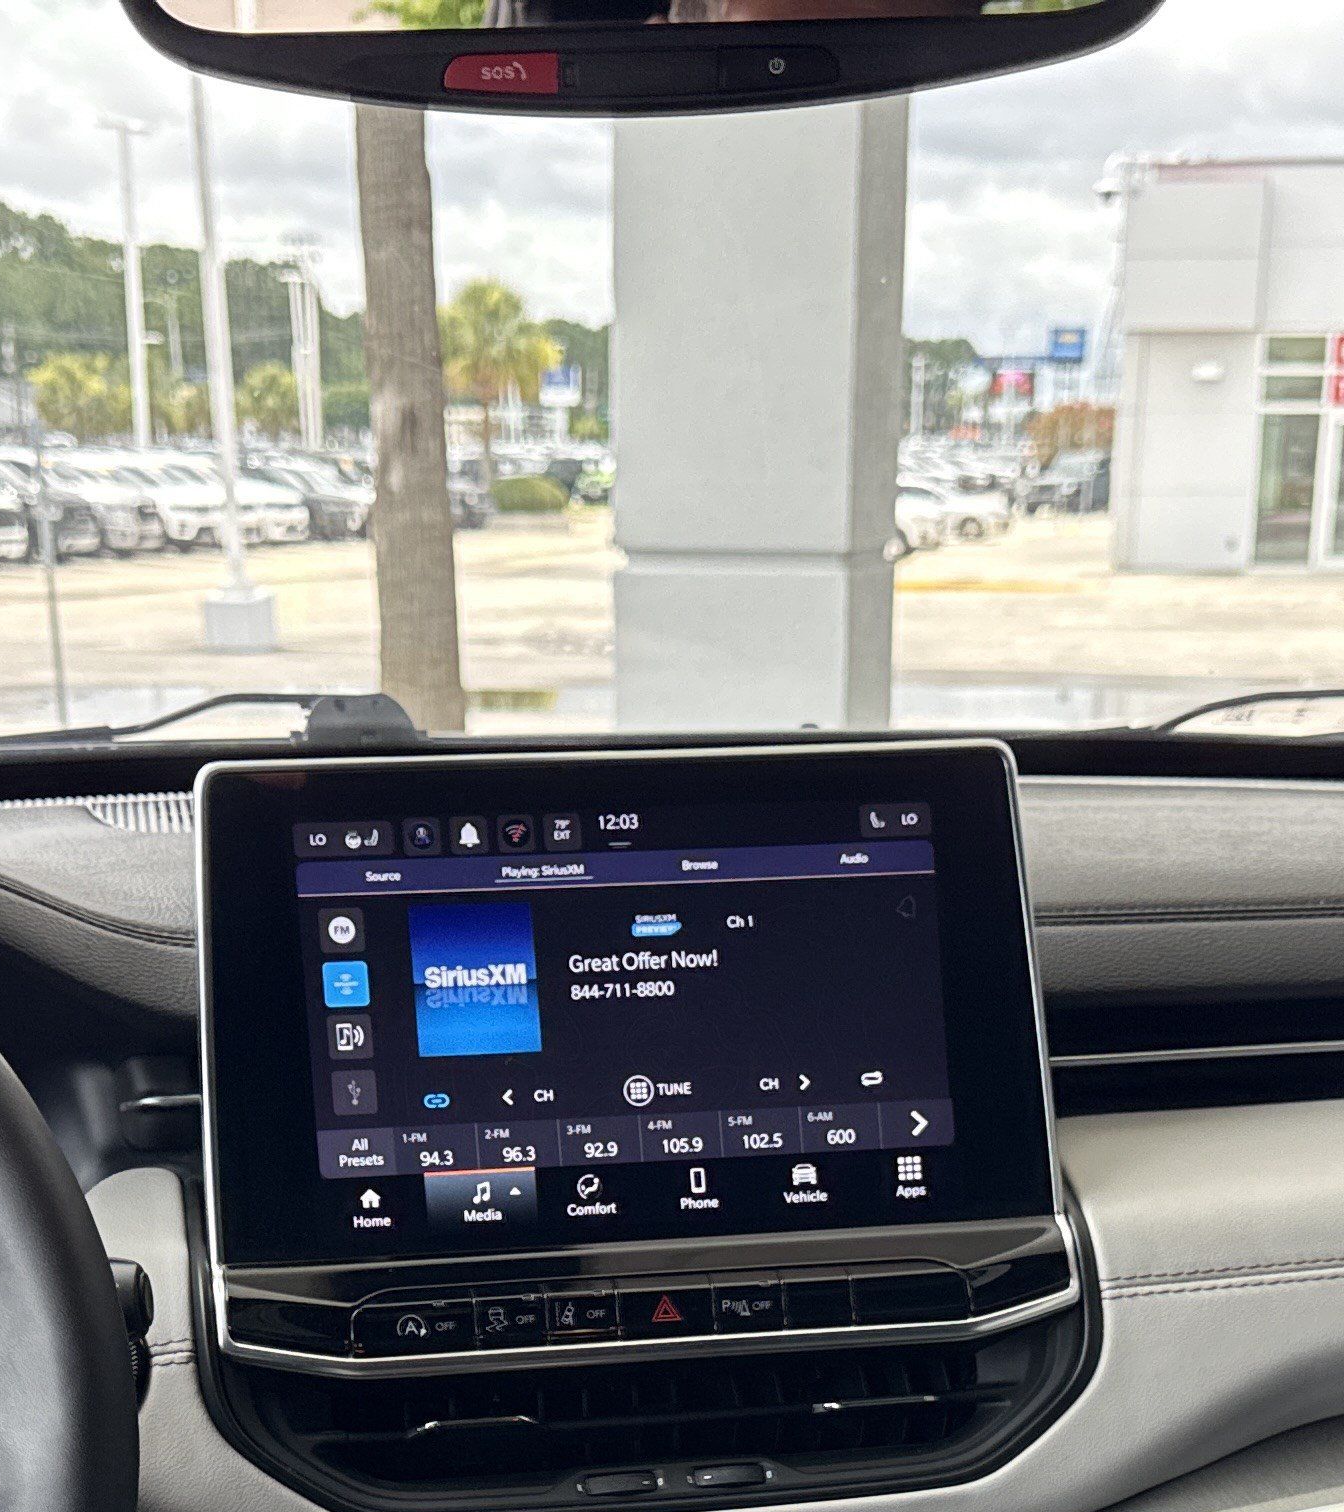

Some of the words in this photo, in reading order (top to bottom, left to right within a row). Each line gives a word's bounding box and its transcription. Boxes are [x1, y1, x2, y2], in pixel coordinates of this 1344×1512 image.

[481, 65, 515, 80] SOS
[598, 813, 639, 831] 12:03
[901, 812, 918, 825] LO
[309, 833, 327, 846] LO
[681, 859, 718, 872] Browse
[839, 852, 869, 865] Audio
[365, 870, 402, 883] Source
[541, 863, 585, 877] SiriusXM
[726, 915, 745, 929] Ch
[747, 915, 754, 928] 1
[333, 924, 351, 936] FM
[568, 953, 620, 973] Great
[622, 951, 669, 971] Offer
[671, 948, 719, 969] Now!
[424, 962, 527, 989] SiriusXM
[570, 980, 675, 1001] 844-711-8800
[656, 1082, 692, 1096] TUNE
[759, 1077, 780, 1091] CH
[534, 1089, 554, 1103] CH
[727, 1115, 753, 1127] 5-FM
[807, 1111, 834, 1123] 6-AM
[566, 1124, 592, 1136] 3-FM
[647, 1119, 673, 1131] 4-FM
[402, 1132, 427, 1144] 1-FM
[484, 1128, 510, 1140] 2-FM
[742, 1132, 783, 1150] 102.5
[826, 1128, 856, 1145] 600
[351, 1137, 369, 1151] All
[583, 1141, 618, 1159] 92.9
[662, 1136, 704, 1154] 105.9
[338, 1153, 384, 1167] Presets
[419, 1150, 454, 1167] 94.3
[502, 1146, 536, 1163] 96.3
[783, 1189, 828, 1204] Vehicle
[896, 1184, 927, 1198] Apps
[566, 1202, 617, 1217] Comfort
[680, 1196, 719, 1210] Phone
[353, 1215, 392, 1228] Home
[463, 1208, 503, 1222] Media
[751, 1300, 773, 1312] OFF
[516, 1313, 537, 1326] OFF
[586, 1308, 606, 1320] OFF
[435, 1320, 456, 1333] OFF
